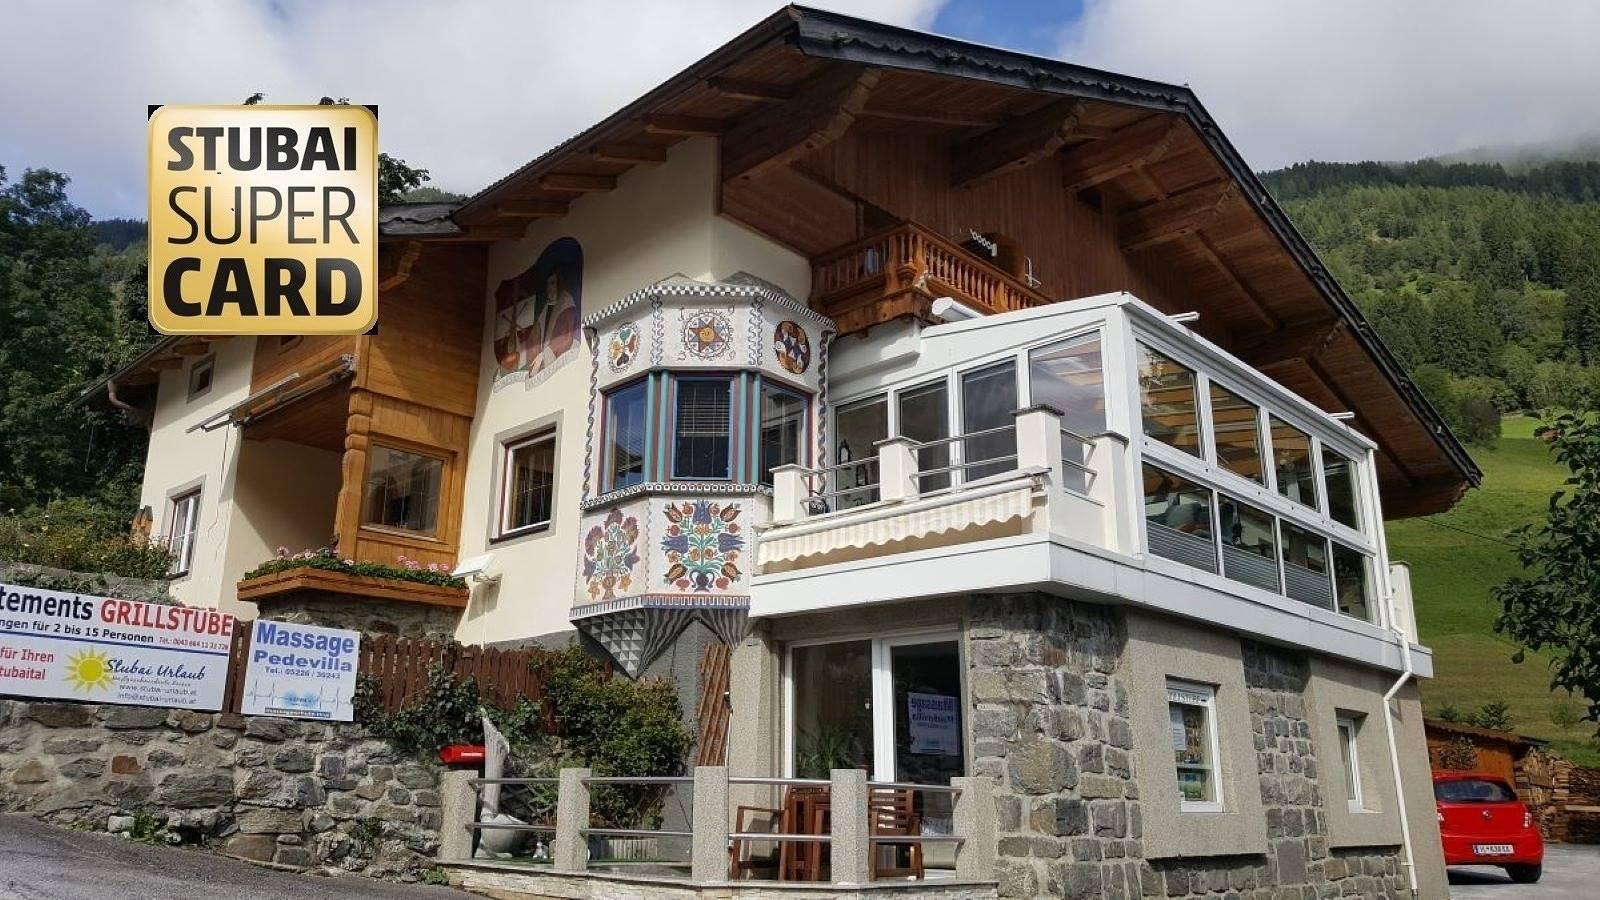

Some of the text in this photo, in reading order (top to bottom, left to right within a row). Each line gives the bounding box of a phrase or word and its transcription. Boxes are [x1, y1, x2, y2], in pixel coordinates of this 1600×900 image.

[100, 599, 234, 637] GRILLSTUBE
[32, 620, 51, 631] für
[53, 623, 61, 633] 2
[64, 624, 82, 635] bis
[85, 627, 99, 637] 15
[102, 628, 154, 643] Personen
[256, 622, 355, 657] Massage
[0, 646, 54, 663] für Ihren
[253, 649, 353, 672] Pedevilla
[105, 659, 153, 676] Stubai
[156, 664, 206, 681] Urlaub
